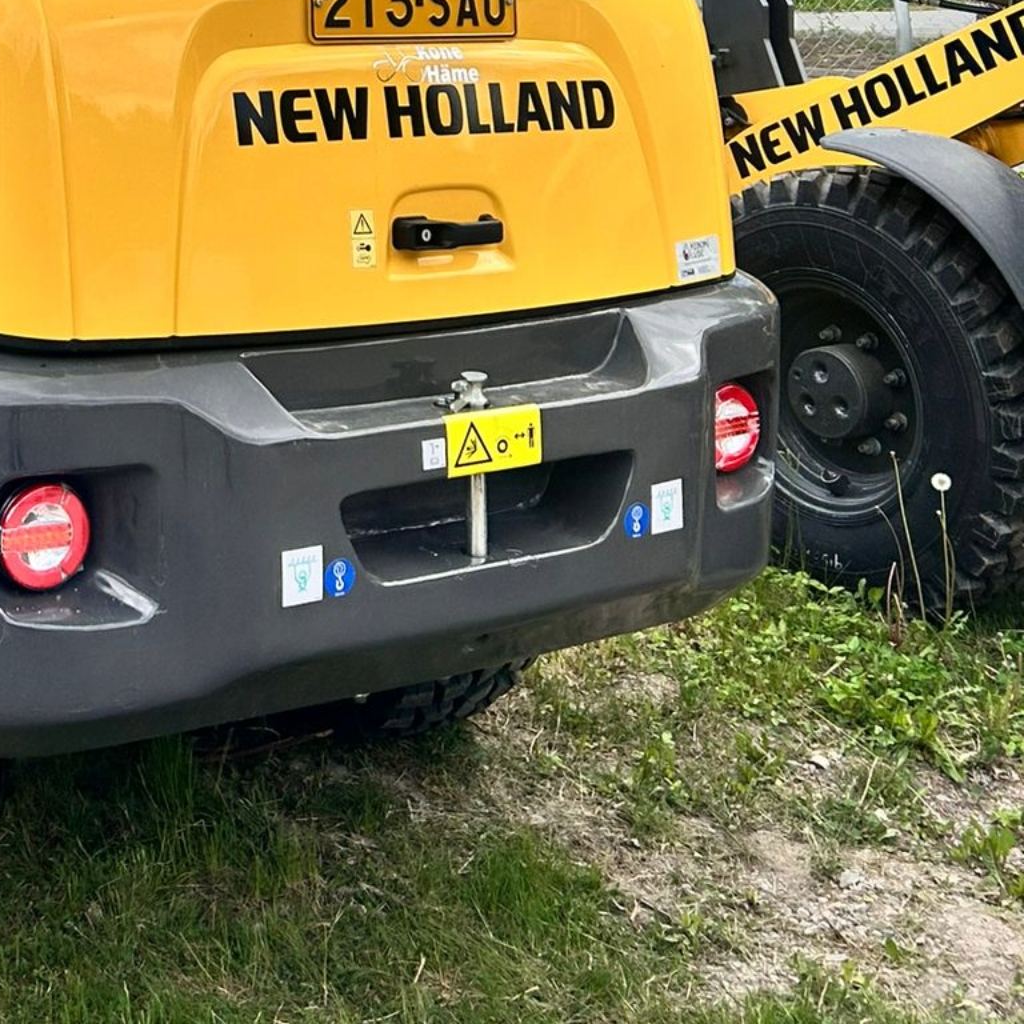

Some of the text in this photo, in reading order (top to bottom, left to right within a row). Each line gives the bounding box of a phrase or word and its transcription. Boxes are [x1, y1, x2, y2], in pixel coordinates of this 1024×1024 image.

[425, 64, 479, 84] Häme
[233, 80, 616, 146] NEW HOLLAND
[728, 103, 826, 179] NEW
